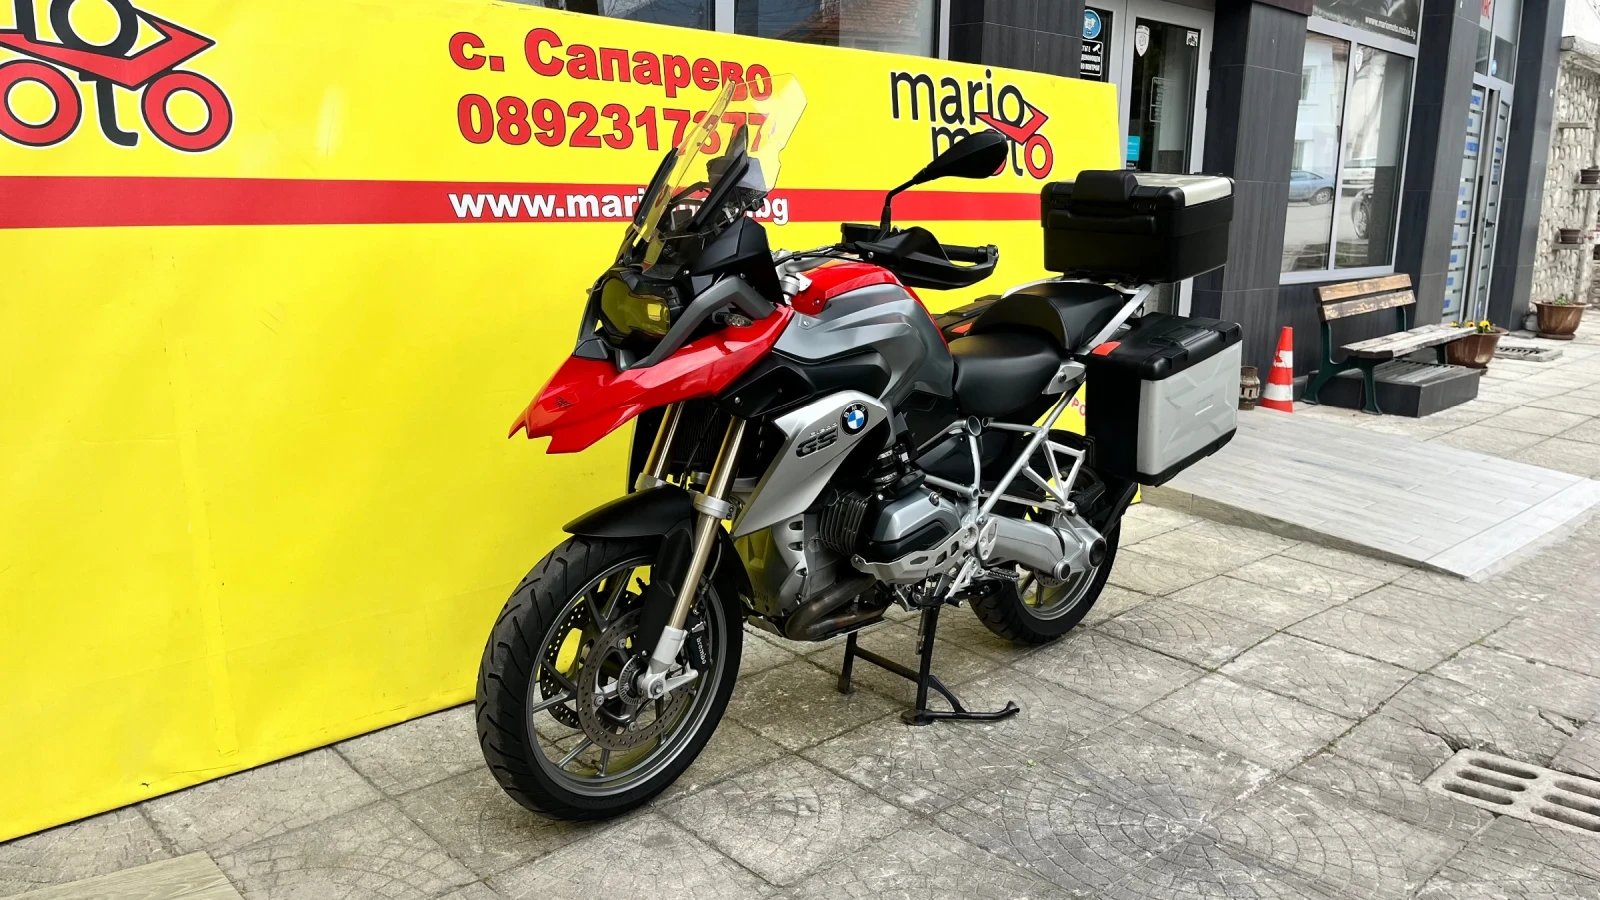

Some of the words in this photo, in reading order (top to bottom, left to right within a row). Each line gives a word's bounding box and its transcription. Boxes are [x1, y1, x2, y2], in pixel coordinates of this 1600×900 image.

[449, 31, 505, 72] с.
[524, 27, 773, 102] Сапарево
[457, 93, 771, 154] 0892317377
[796, 427, 838, 458] GS
[696, 635, 707, 665] brembo
